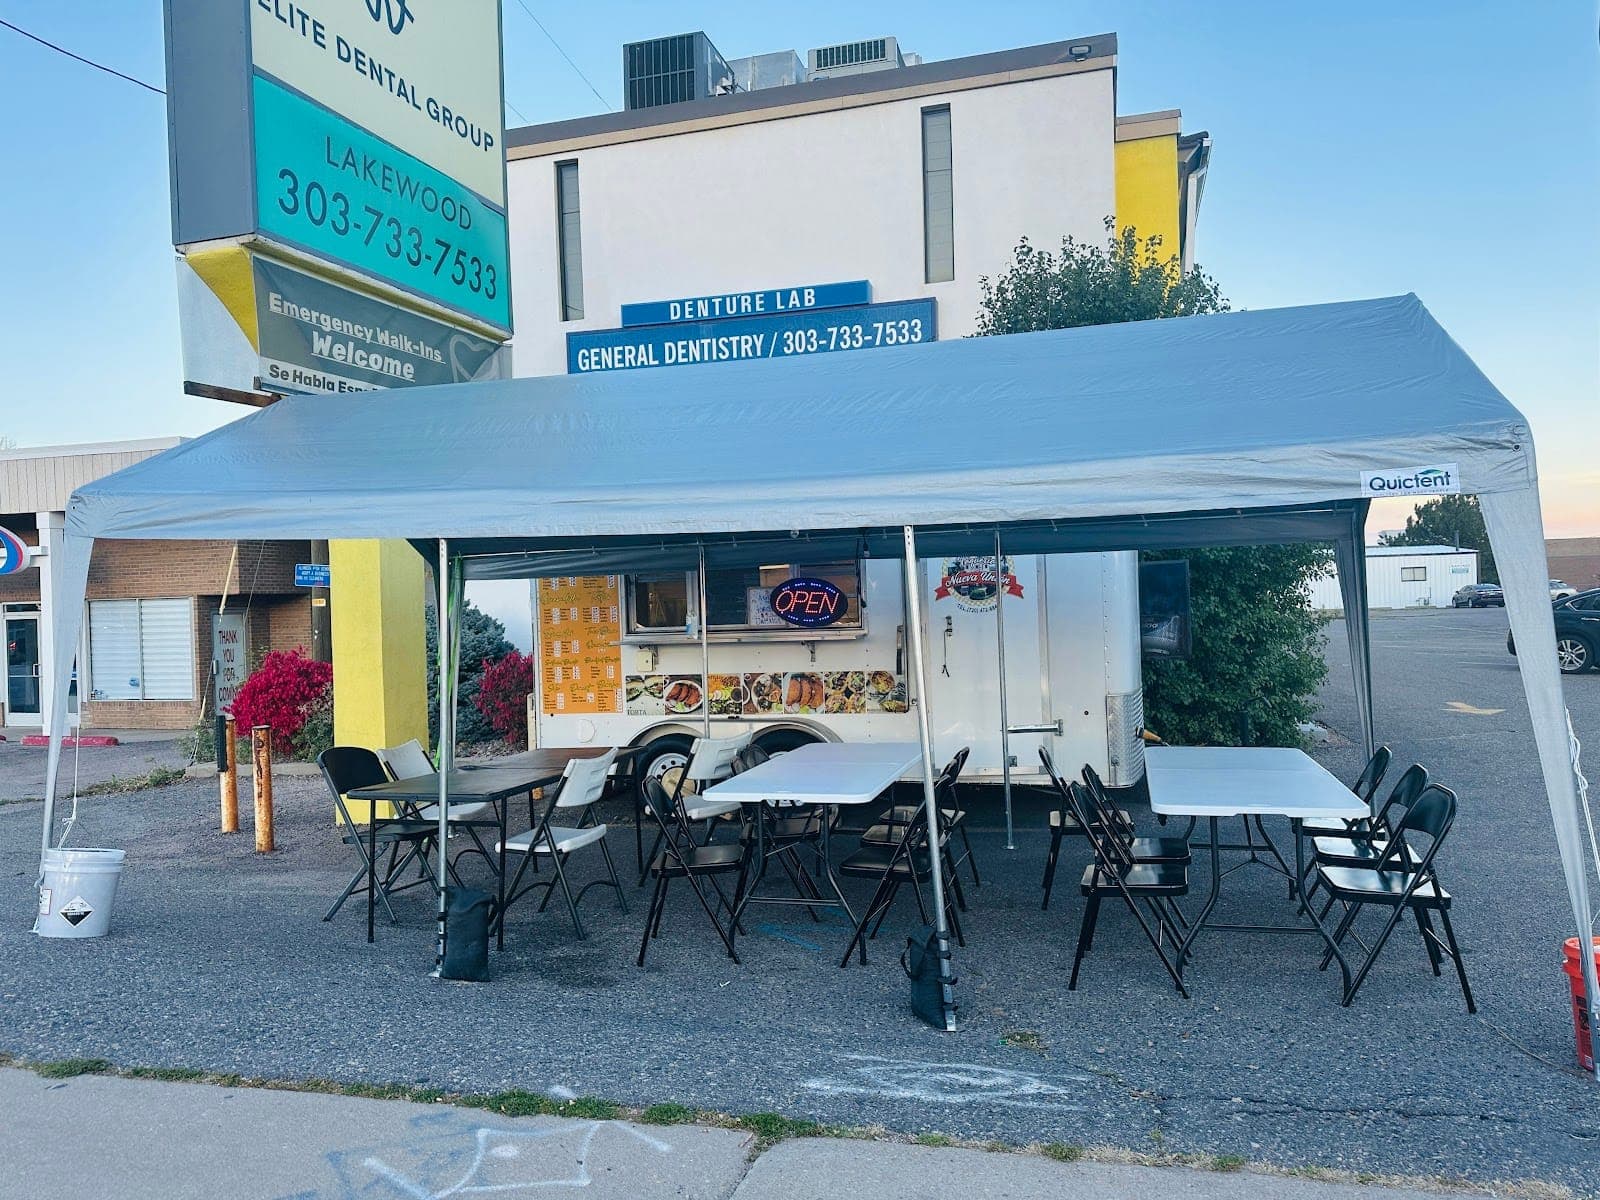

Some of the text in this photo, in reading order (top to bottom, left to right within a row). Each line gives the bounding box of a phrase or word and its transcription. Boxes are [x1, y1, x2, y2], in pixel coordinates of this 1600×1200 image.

[258, 0, 494, 152] LITE DENTAL GROUP
[326, 135, 472, 230] LAKEWOOD
[278, 168, 497, 300] 303-733-7533
[669, 287, 816, 321] DENTURE LAB
[268, 291, 442, 362] Emergency Walk-Ins
[311, 331, 415, 379] Welcome
[577, 343, 659, 372] GENERAL
[664, 333, 765, 366] DENTISTRY
[782, 318, 923, 355] 303-733-7533
[269, 364, 290, 381] Se
[292, 371, 335, 393] Habla
[1369, 471, 1451, 491] Quictent
[945, 570, 1011, 587] Nueva Unn
[775, 590, 840, 614] OPEN
[218, 630, 238, 645] THANK
[222, 647, 235, 663] YOU
